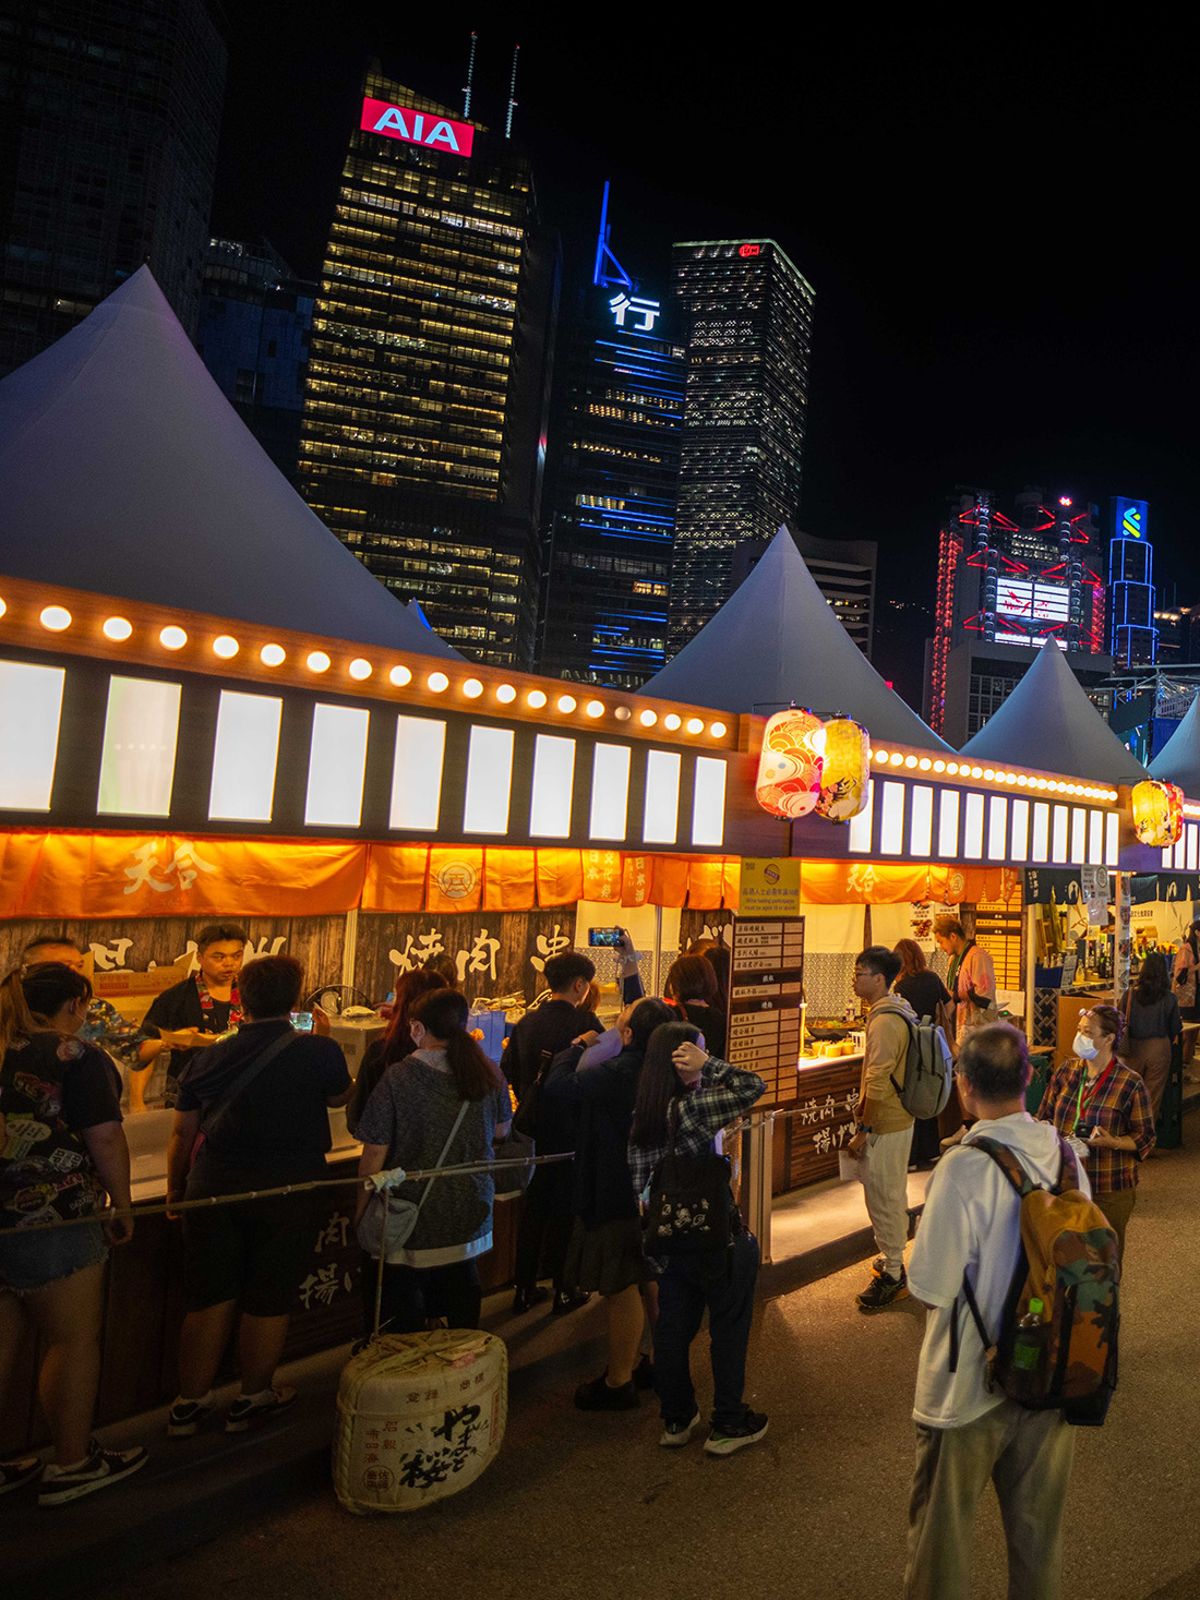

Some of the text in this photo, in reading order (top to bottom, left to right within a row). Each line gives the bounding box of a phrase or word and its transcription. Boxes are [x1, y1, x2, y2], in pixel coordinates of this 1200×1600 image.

[373, 107, 460, 152] AIA
[609, 292, 661, 332] 行
[124, 841, 220, 895] 天合
[846, 863, 881, 893] 天合
